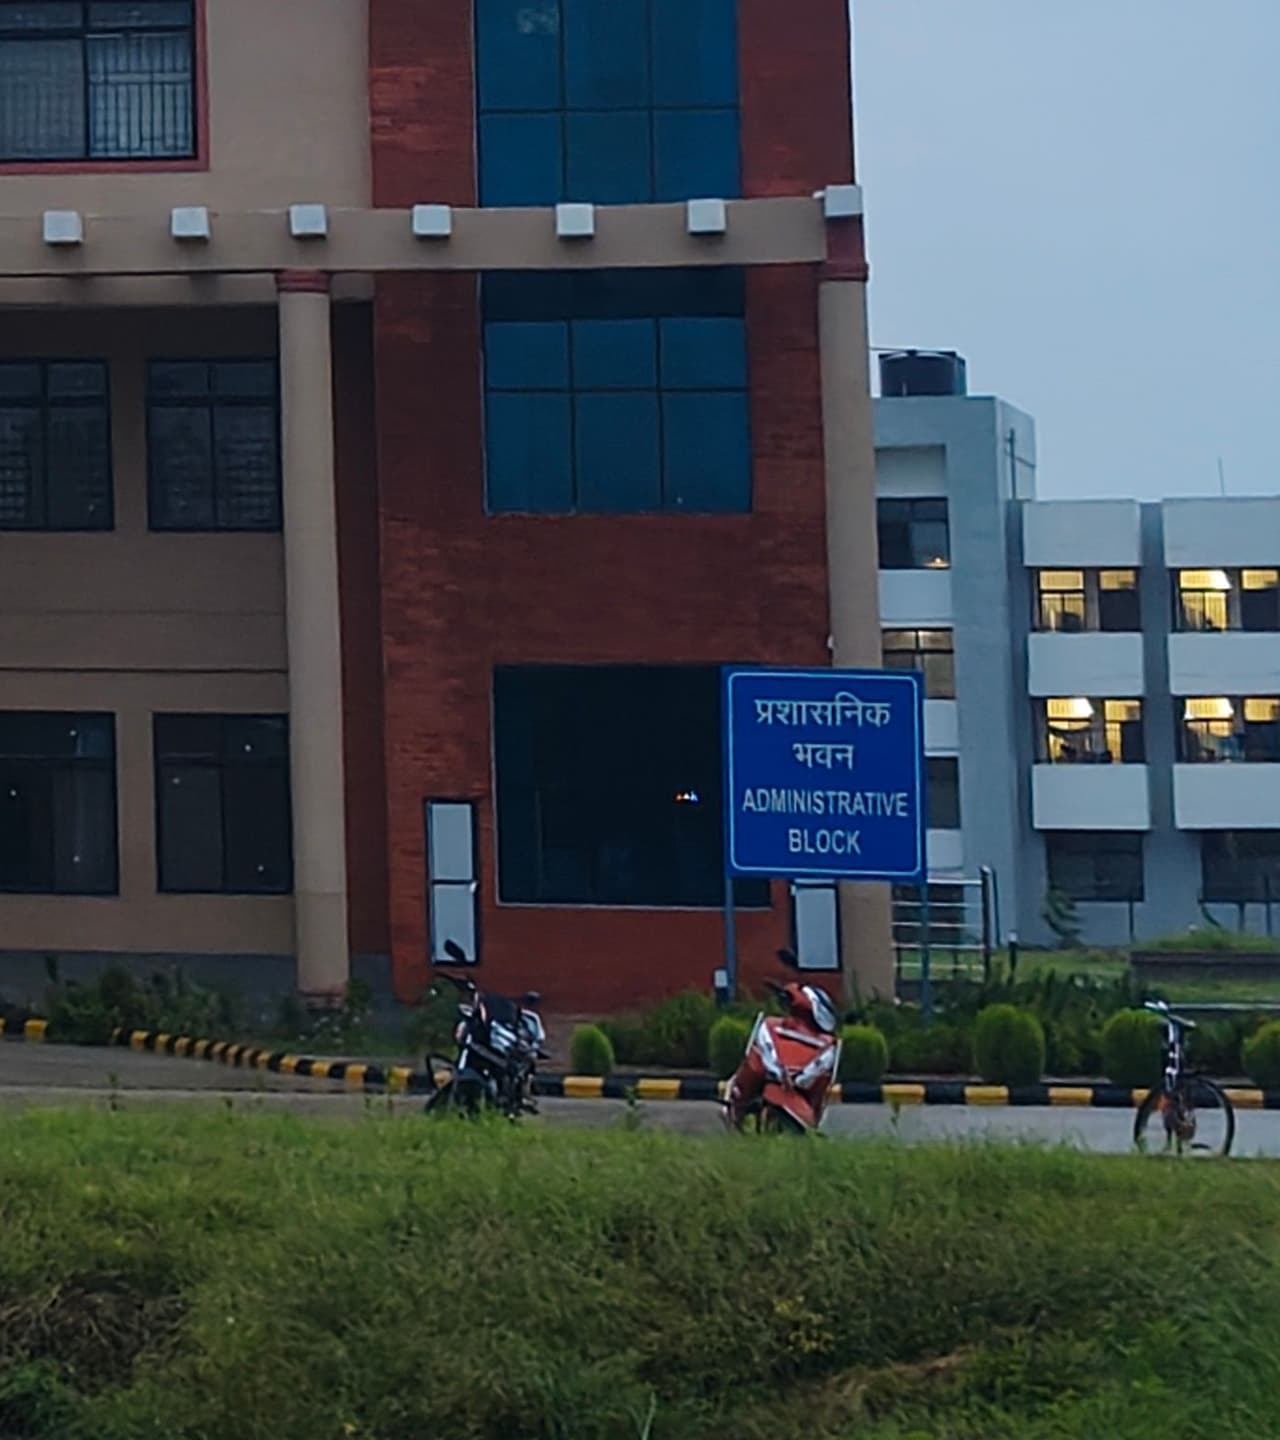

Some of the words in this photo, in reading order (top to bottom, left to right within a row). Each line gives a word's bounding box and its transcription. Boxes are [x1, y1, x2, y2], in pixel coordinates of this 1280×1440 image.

[754, 691, 892, 728] प्रशासनिक
[792, 742, 855, 770] भवन
[742, 788, 909, 817] ADMINISTRATIVE
[788, 828, 861, 855] BLOCK
